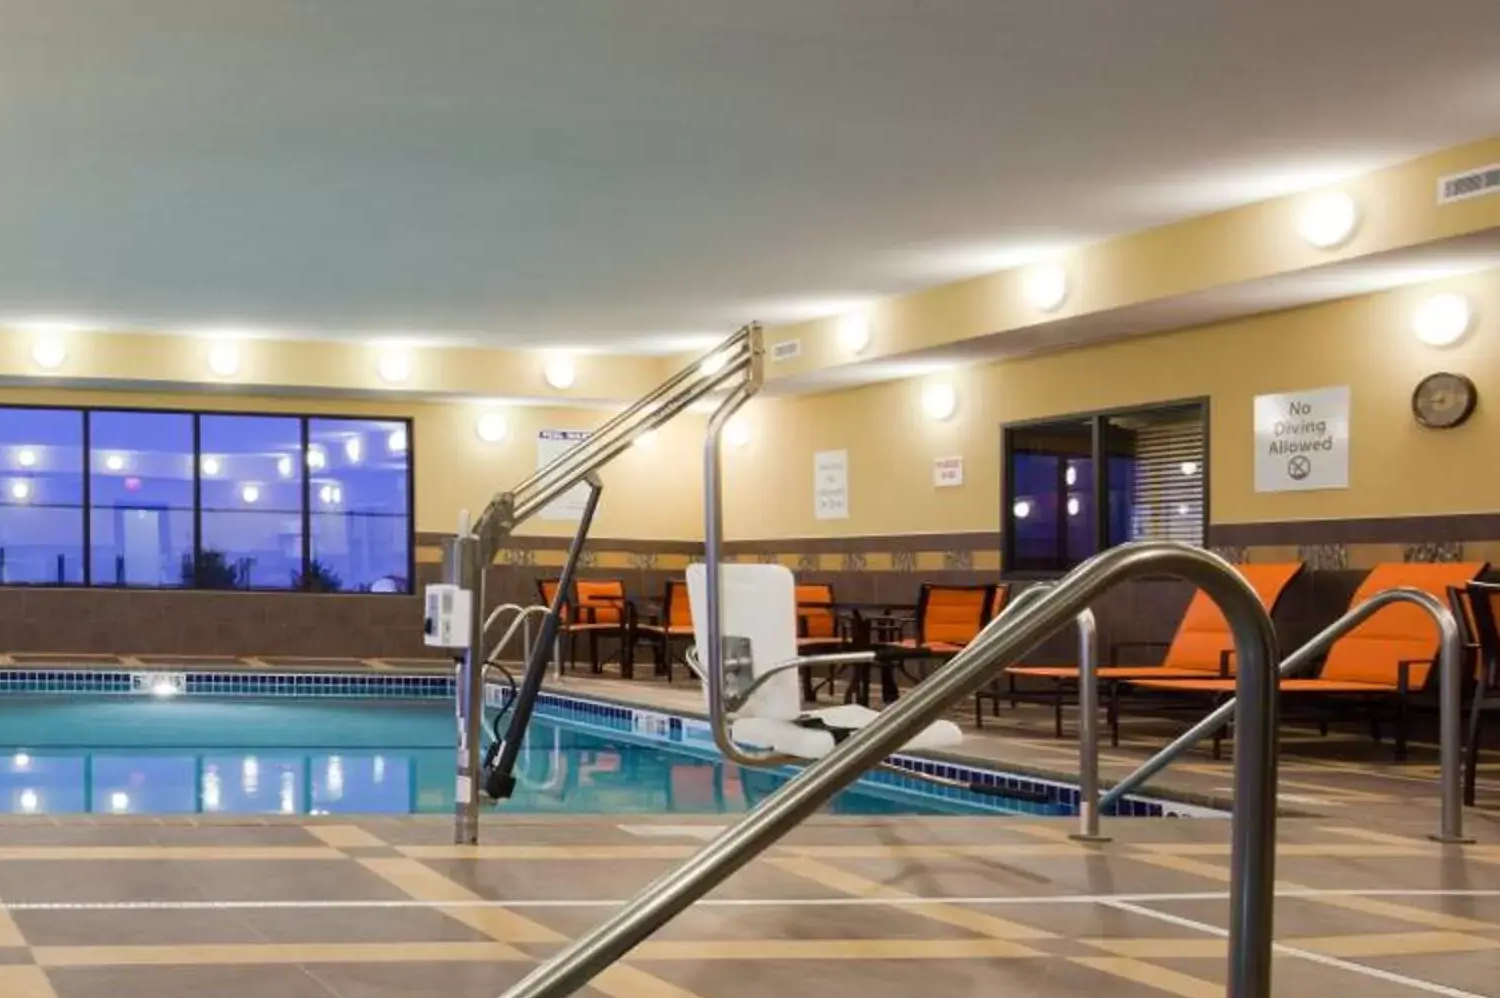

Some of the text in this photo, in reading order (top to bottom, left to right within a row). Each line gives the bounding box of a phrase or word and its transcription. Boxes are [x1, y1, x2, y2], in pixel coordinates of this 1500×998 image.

[1289, 400, 1311, 416] No
[1274, 420, 1326, 437] Diving
[1268, 434, 1333, 456] Allowed
